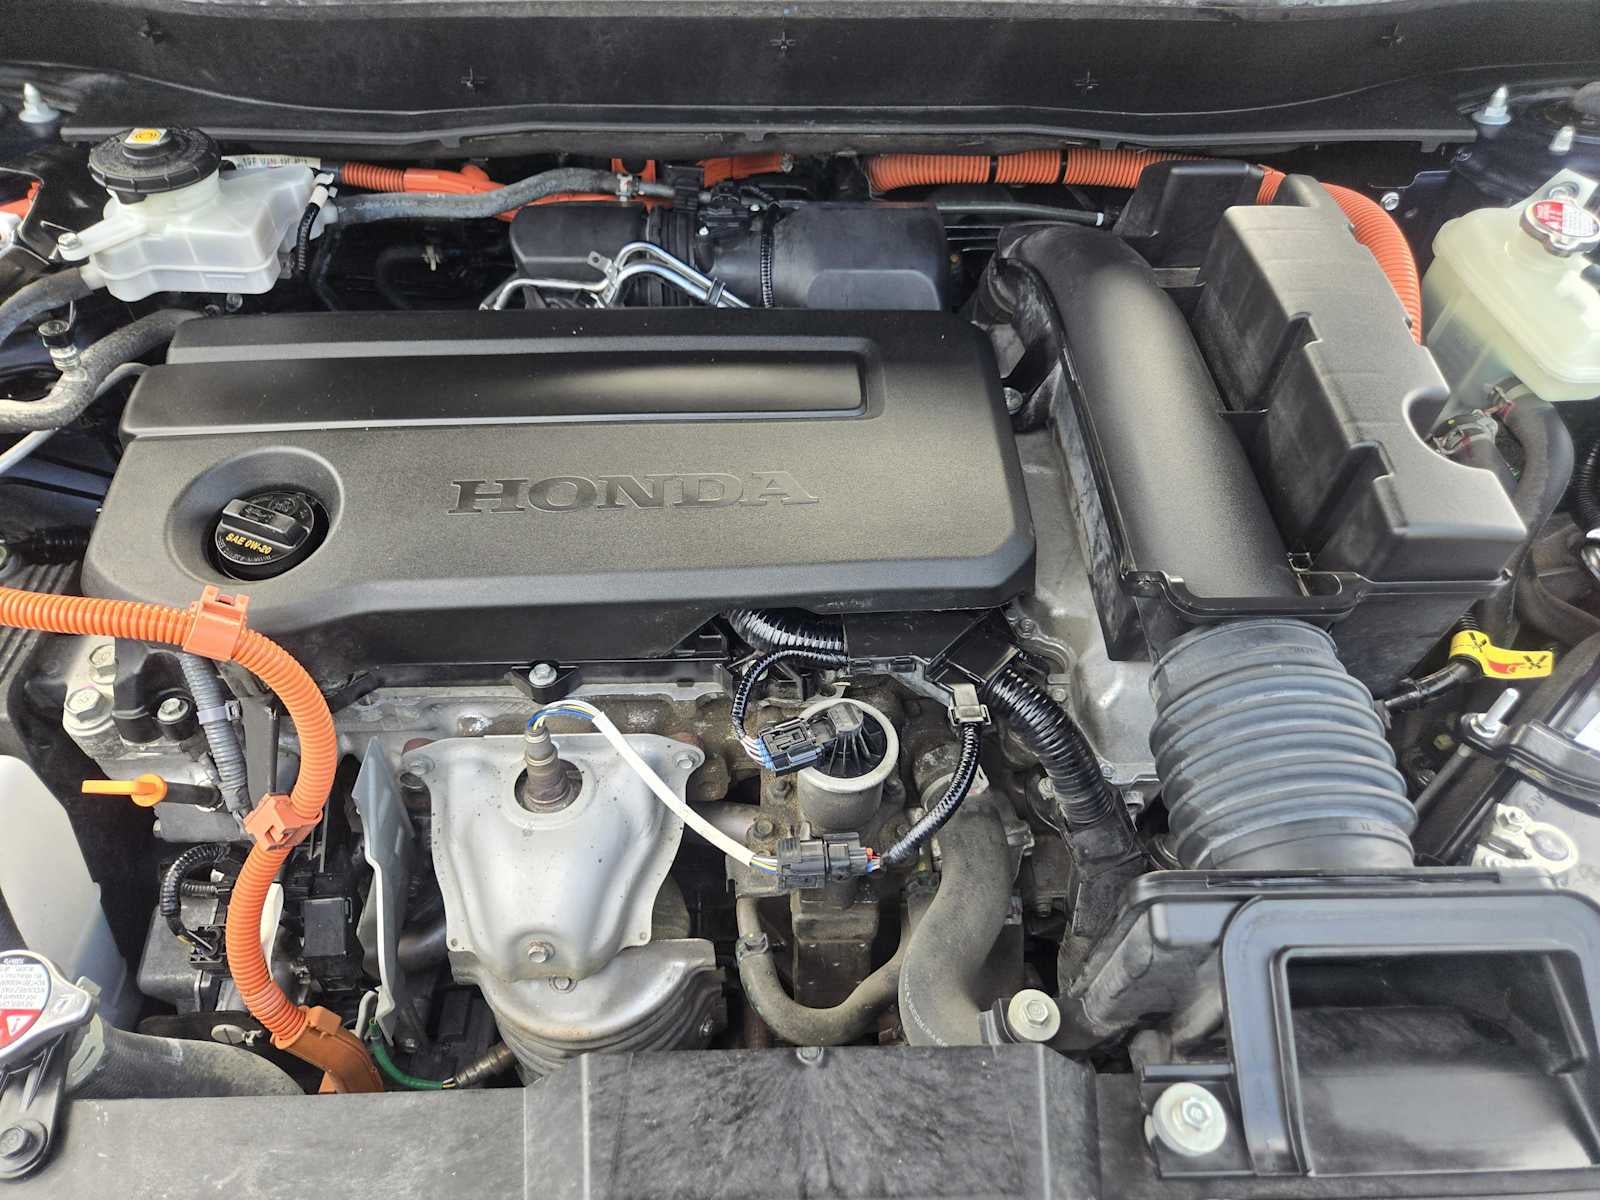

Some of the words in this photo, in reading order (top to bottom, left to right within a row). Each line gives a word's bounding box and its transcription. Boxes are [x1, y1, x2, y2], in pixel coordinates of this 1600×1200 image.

[448, 471, 819, 515] HONDA
[225, 533, 247, 545] SAE
[244, 539, 273, 555] 0W-20
